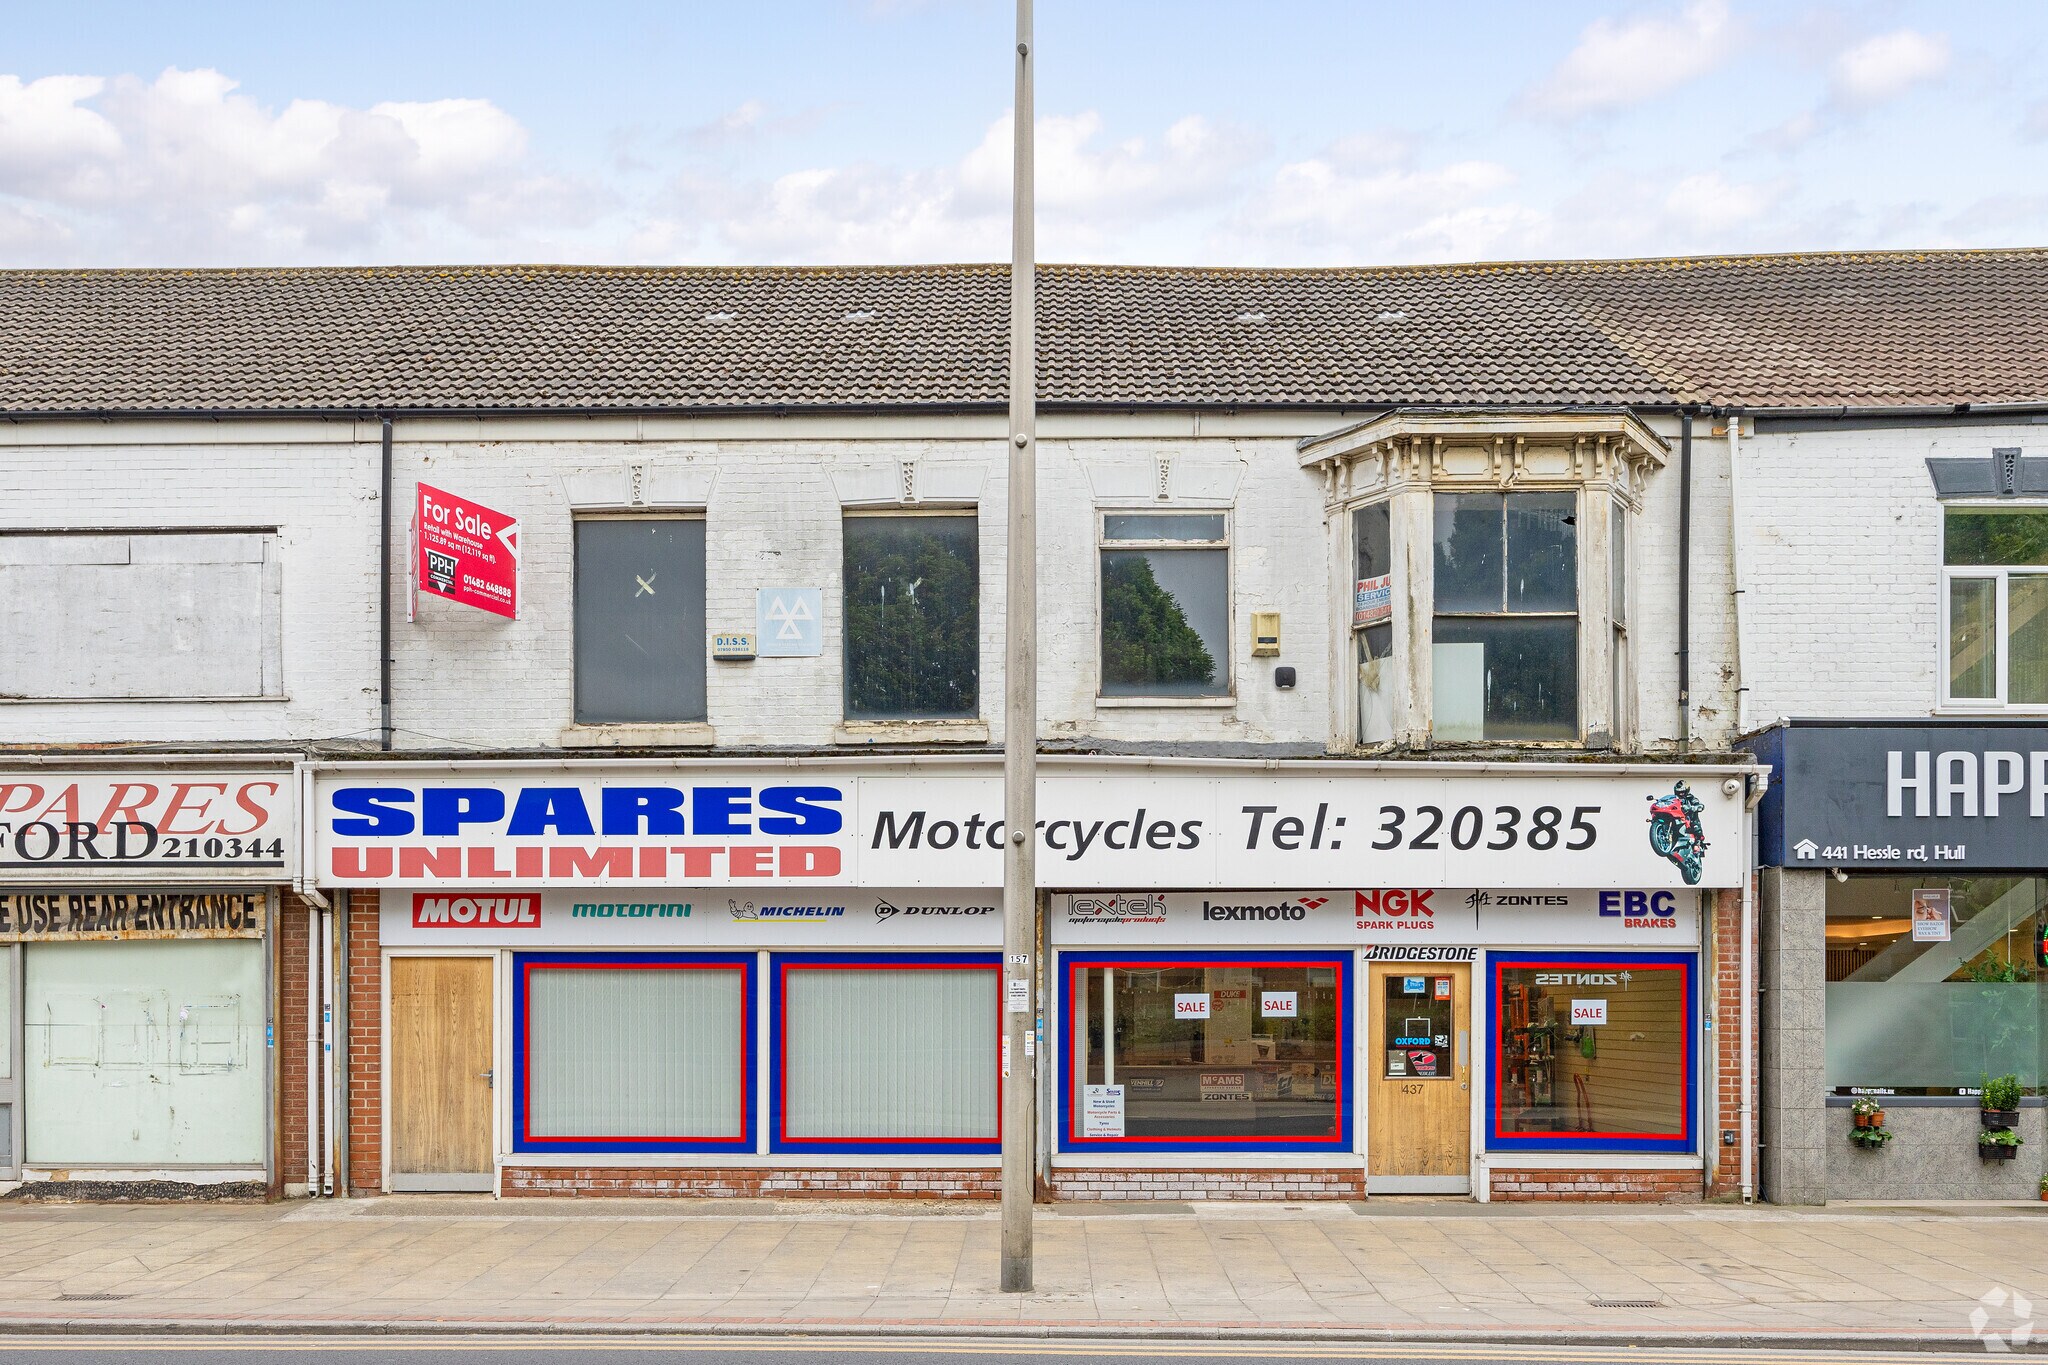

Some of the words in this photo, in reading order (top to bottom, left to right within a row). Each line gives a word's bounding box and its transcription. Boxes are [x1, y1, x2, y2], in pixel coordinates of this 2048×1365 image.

[424, 494, 450, 525] For
[455, 506, 492, 540] Sale
[424, 521, 440, 534] Retail
[441, 529, 452, 539] with
[453, 532, 484, 550] Warehouse
[430, 554, 454, 576] PPH
[463, 574, 485, 590] 01482
[486, 582, 512, 598] 648888
[1357, 579, 1379, 593] PHIL
[717, 637, 750, 646] D.I.S.S.
[0, 782, 279, 835] PARES
[332, 786, 843, 838] SPARES
[1241, 803, 1347, 851] Tel:
[1371, 805, 1602, 851] 320385
[162, 837, 285, 859] 210344
[1821, 845, 1848, 860] 441
[1853, 845, 1901, 860] Hessle
[1906, 845, 1928, 862] rd,
[1934, 845, 1966, 860] Hull
[332, 846, 842, 878] UNLIMITED
[1355, 889, 1435, 918] NGK
[1496, 895, 1568, 906] ZONTES
[1599, 890, 1676, 917] EBC
[16, 894, 61, 934] USE
[67, 894, 128, 932] REAR
[134, 893, 256, 931] ENTRANCE
[418, 898, 536, 924] MOTUL
[572, 903, 692, 918] motorini
[759, 906, 846, 917] MICHELIN
[903, 906, 996, 916] DUNLOP
[1203, 901, 1306, 921] lexmoto
[1356, 921, 1394, 930] SPARK
[1397, 921, 1435, 930] PLUGS
[1624, 918, 1677, 929] BRAKES
[1364, 945, 1478, 960] BRIDGESTONE
[1220, 990, 1241, 998] DUKE
[1177, 1002, 1206, 1013] SALE
[1264, 1000, 1293, 1011] SALE
[1574, 1007, 1603, 1019] SALE
[1395, 1037, 1431, 1045] OXFORD
[1204, 1093, 1250, 1101] ZONTES
[1402, 1085, 1424, 1095] 437
